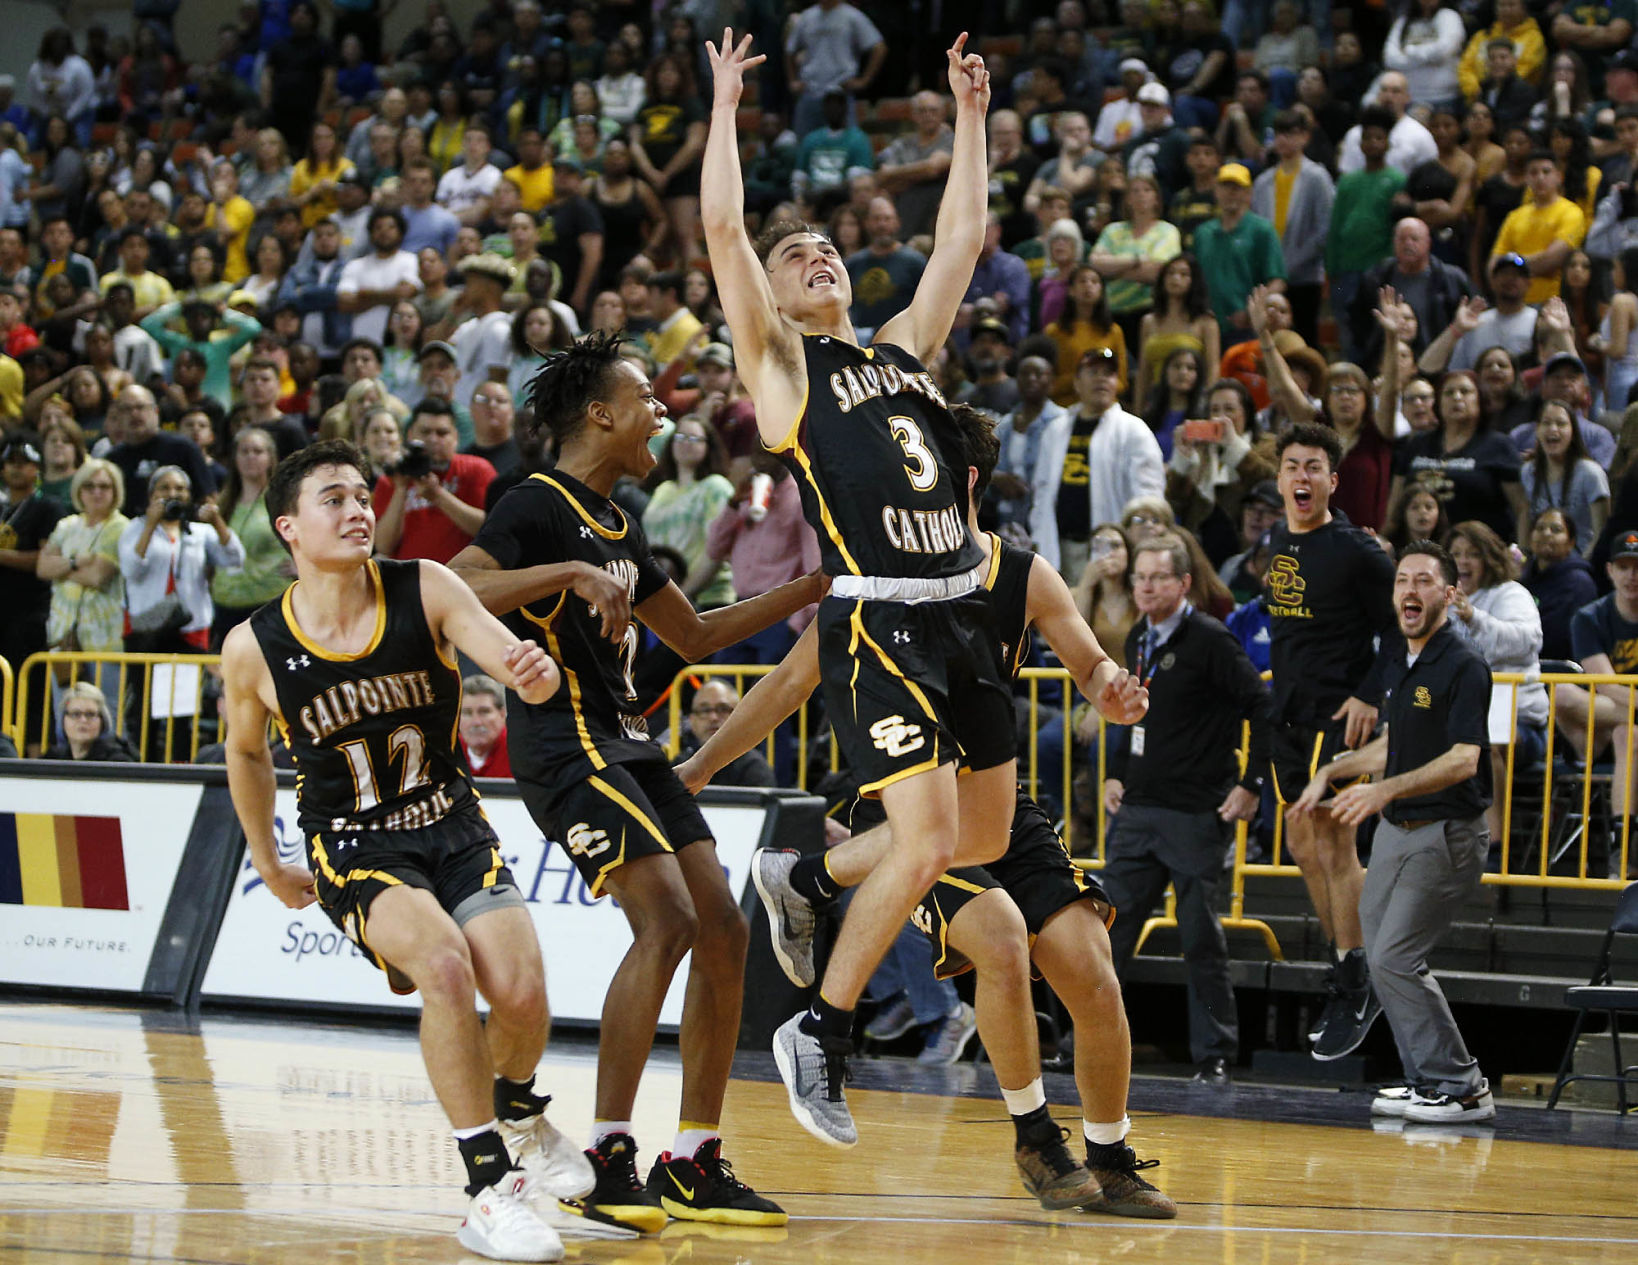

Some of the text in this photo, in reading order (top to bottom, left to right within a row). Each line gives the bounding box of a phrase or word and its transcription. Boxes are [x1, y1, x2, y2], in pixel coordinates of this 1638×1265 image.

[887, 415, 939, 492] 3
[882, 502, 965, 554] CATHOLI
[300, 670, 436, 746] SALPOINTE
[334, 723, 433, 814] 12
[280, 921, 367, 963] Sport
